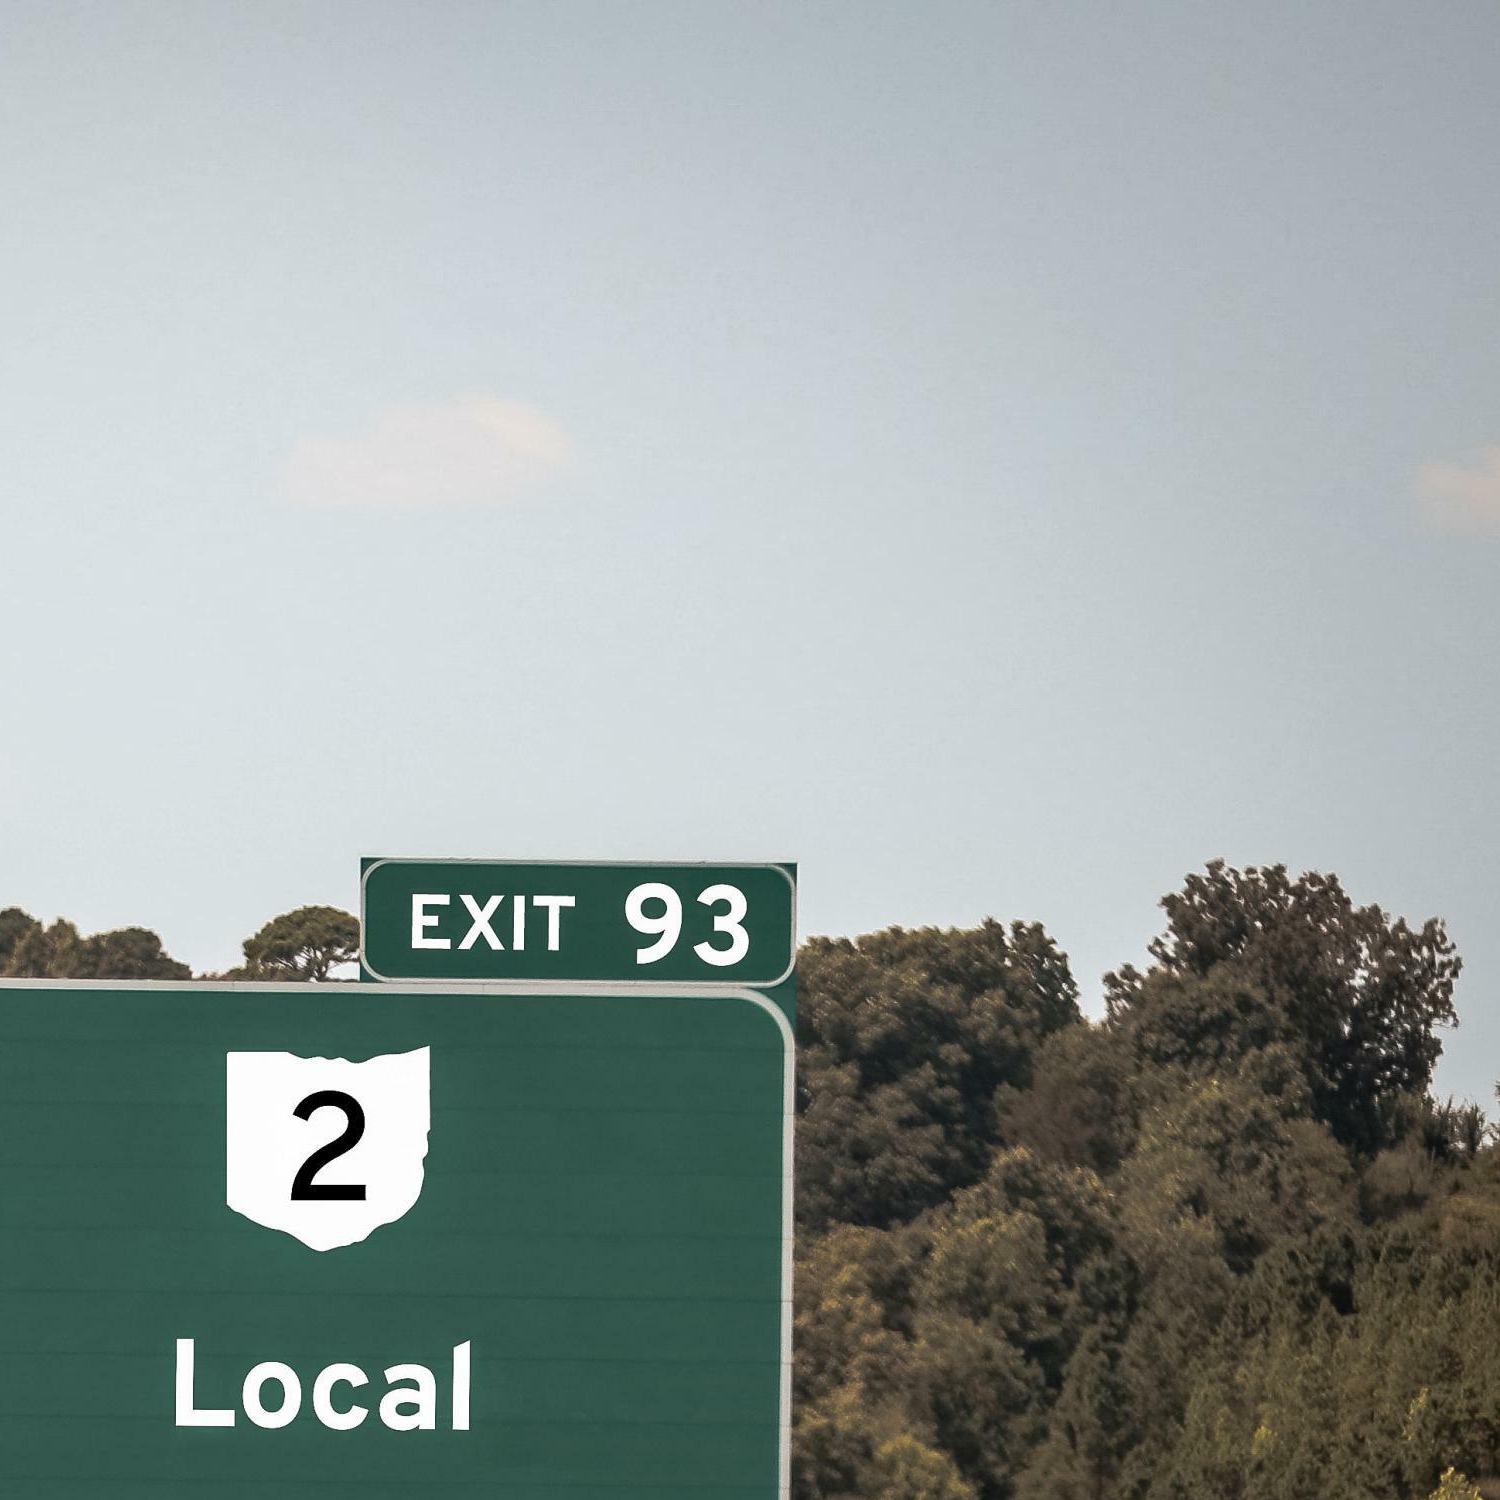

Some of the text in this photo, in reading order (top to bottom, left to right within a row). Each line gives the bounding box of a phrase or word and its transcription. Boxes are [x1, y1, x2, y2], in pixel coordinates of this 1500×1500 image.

[410, 883, 751, 967] EXIT 93
[290, 1090, 367, 1202] 2
[174, 1338, 472, 1432] Local
